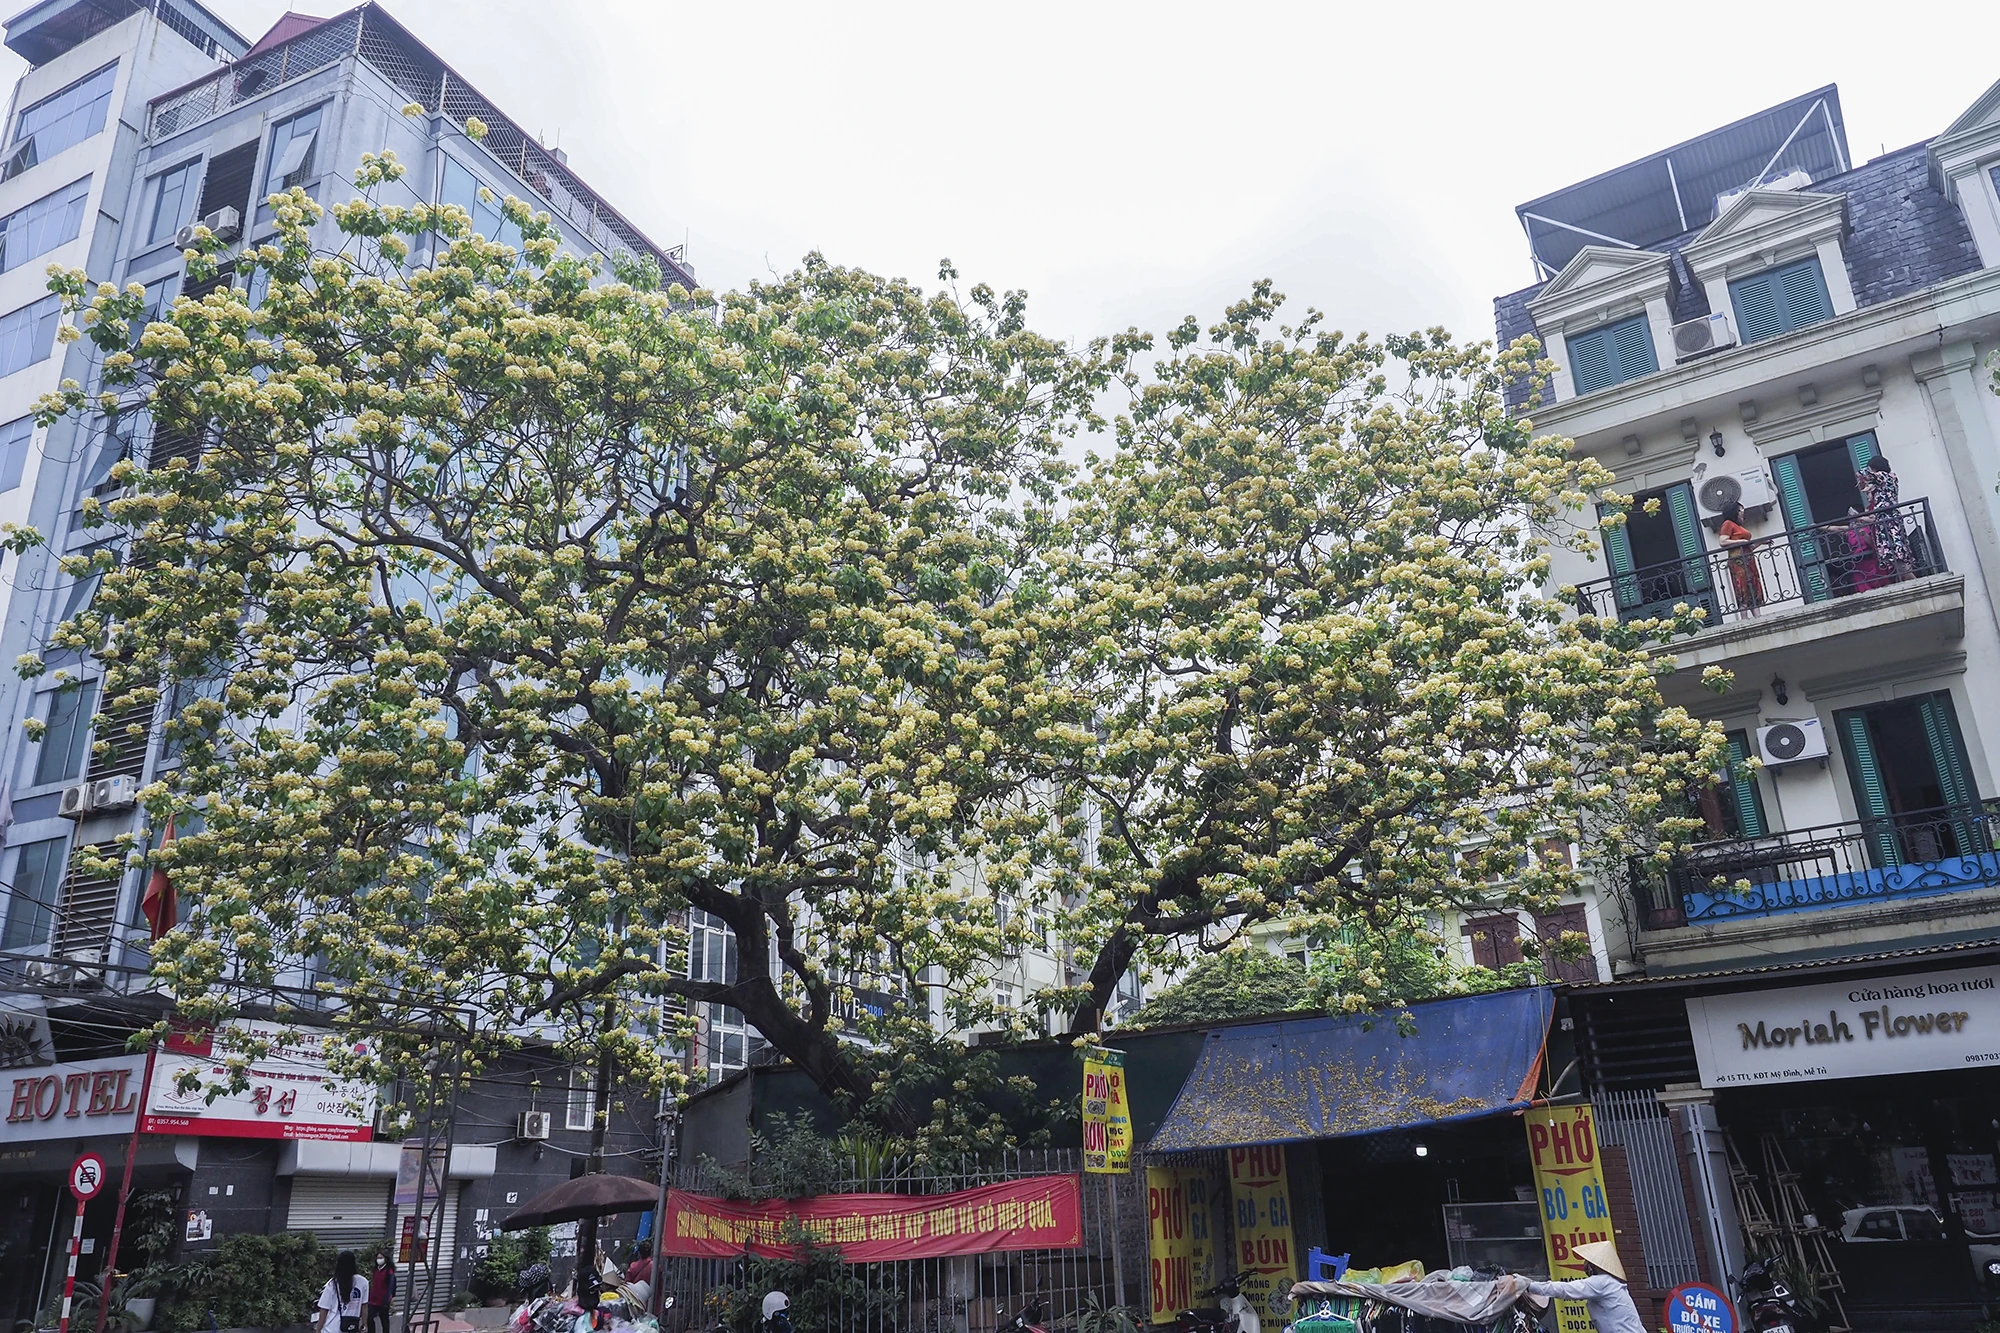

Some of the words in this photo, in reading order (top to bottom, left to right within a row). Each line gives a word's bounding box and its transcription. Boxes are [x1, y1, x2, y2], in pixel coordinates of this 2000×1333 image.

[1848, 988, 1881, 1002] Cửa
[1884, 985, 1926, 999] hàng
[1927, 983, 1959, 995] hoa
[1738, 1010, 1853, 1050] Moriah
[1859, 1005, 1968, 1039] Flower
[1965, 1053, 2000, 1062] 0981703
[1085, 1069, 1107, 1099] PHỞ
[1753, 1071, 1768, 1080] KĐT
[6, 1069, 137, 1123] HOTEL
[1084, 1117, 1105, 1152] BÚN
[1528, 1106, 1594, 1166] PHỞ
[1150, 1170, 1182, 1240] PHỞ
[1237, 1191, 1257, 1229] BÒ
[1269, 1190, 1289, 1227] GÀ
[1543, 1179, 1568, 1221] BÒ
[1581, 1178, 1608, 1219] GÀ
[835, 1212, 867, 1243] CHỮA
[870, 1210, 900, 1240] CHÁY
[905, 1211, 925, 1244] KỊP
[929, 1204, 956, 1237] THỜI
[959, 1201, 975, 1234] VÀ
[978, 1198, 994, 1232] CÓ
[998, 1196, 1025, 1236] HIỆU
[1028, 1190, 1056, 1232] QUẢ.
[1241, 1234, 1289, 1265] BÚN
[1152, 1246, 1188, 1313] BÚN
[1564, 1306, 1584, 1318] THỊT
[1685, 1292, 1716, 1311] CẤM
[1567, 1320, 1587, 1333] DỌC
[1681, 1309, 1699, 1324] ĐỖ
[1703, 1314, 1720, 1329] XE
